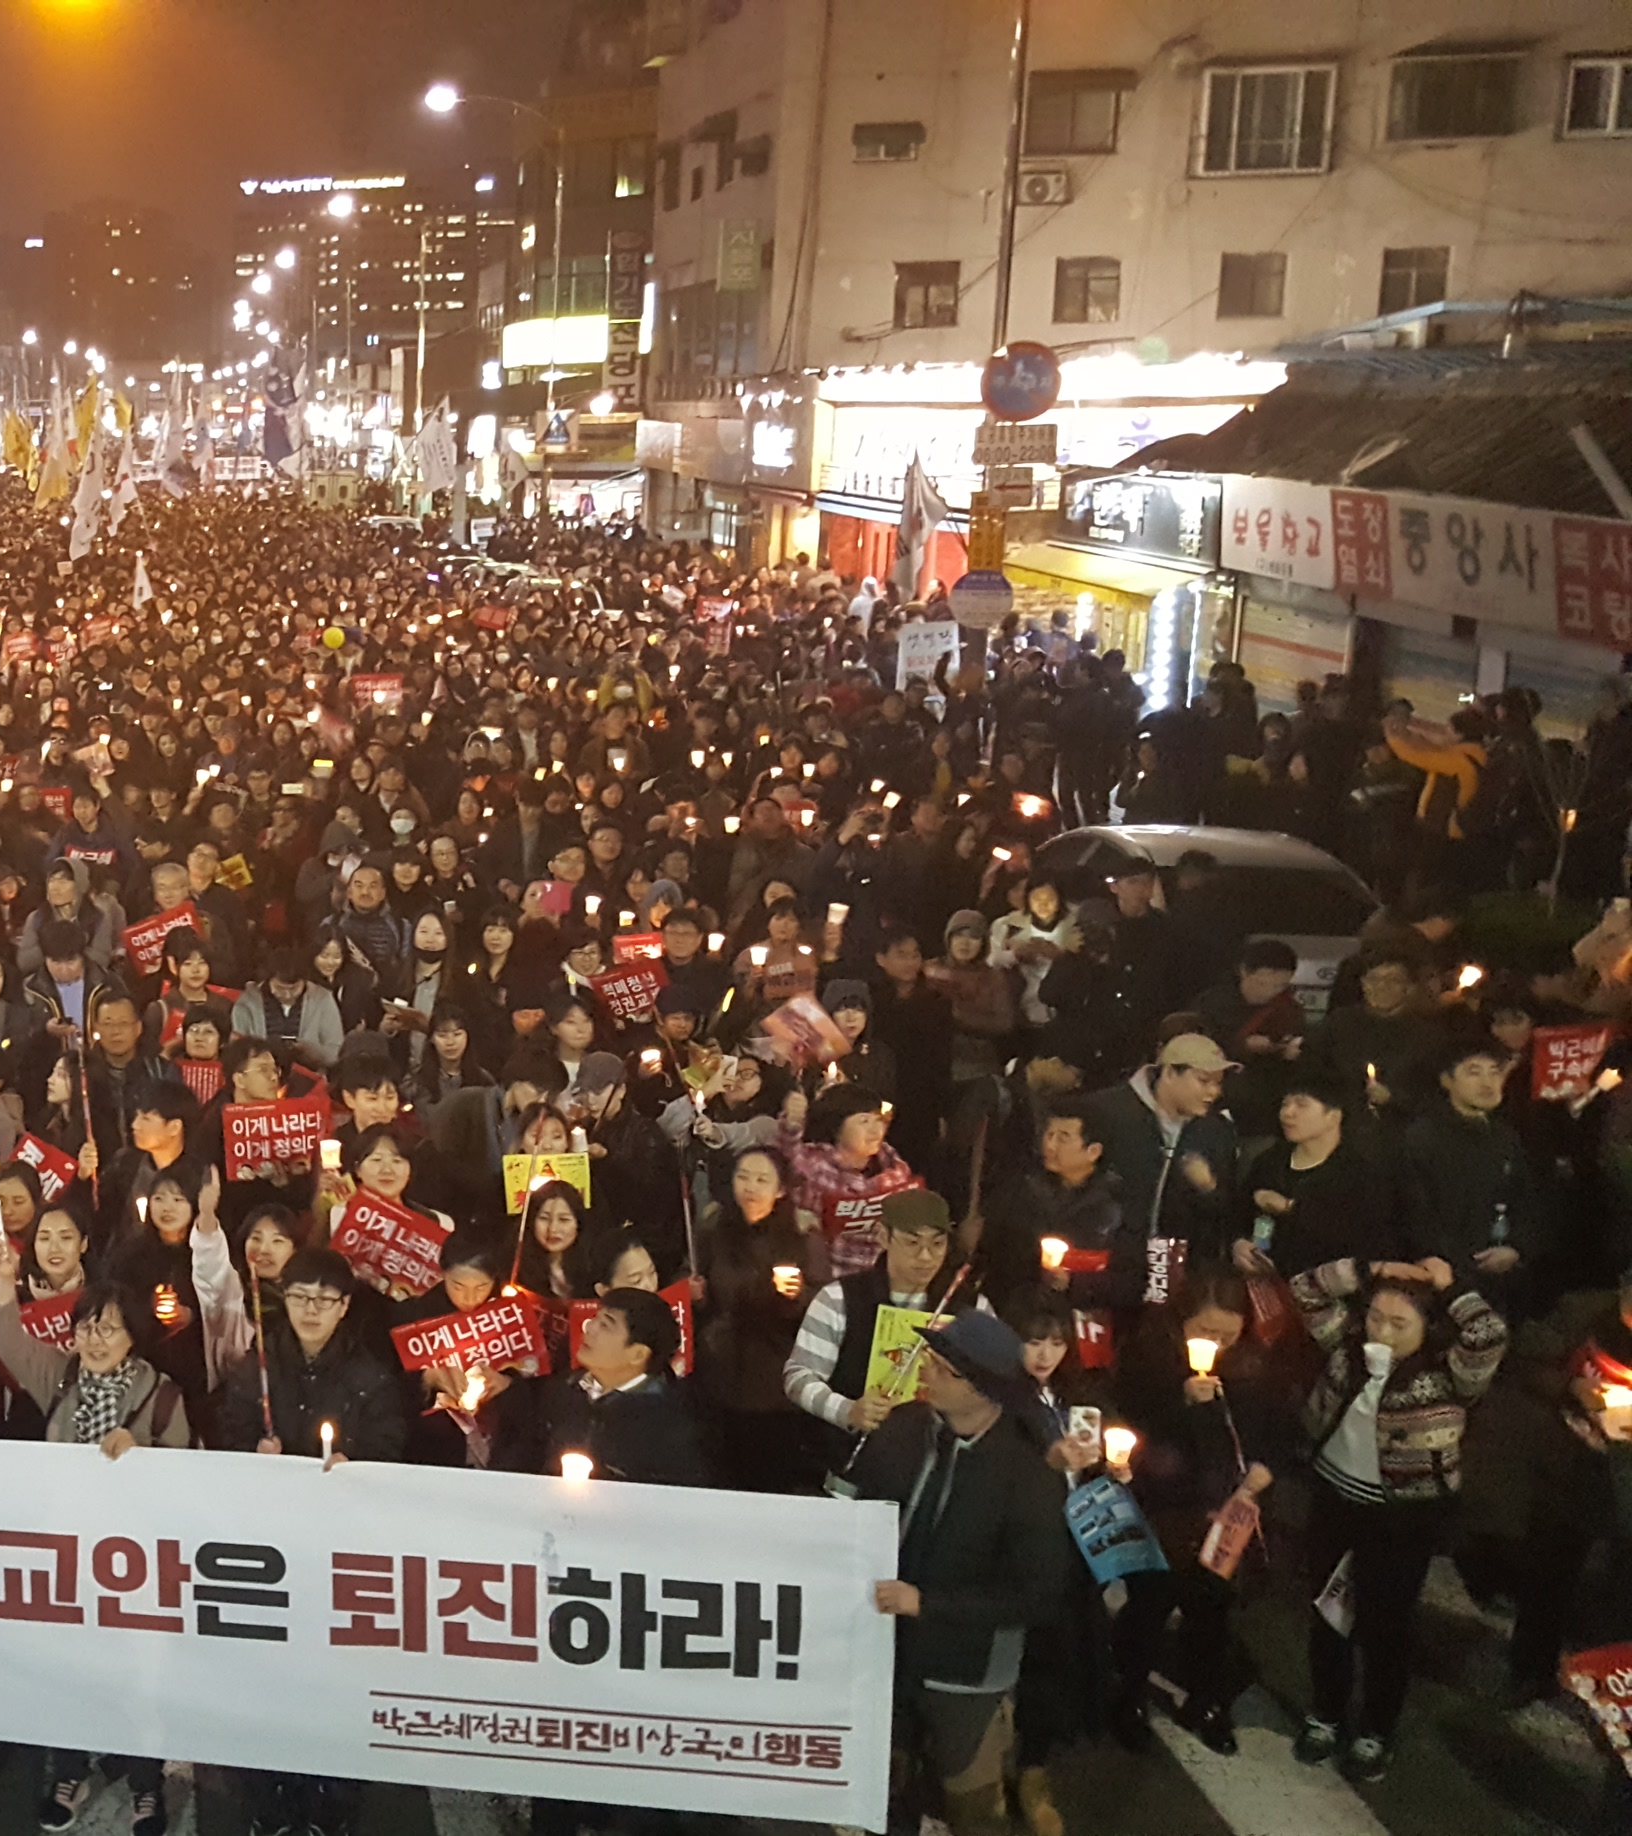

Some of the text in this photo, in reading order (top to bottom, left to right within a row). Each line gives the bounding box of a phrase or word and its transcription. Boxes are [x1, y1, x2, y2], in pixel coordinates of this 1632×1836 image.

[1399, 507, 1539, 593] 중앙사
[232, 1110, 321, 1138] 이게 나라다
[234, 1139, 270, 1160] 이게
[355, 1206, 396, 1240] 이게
[407, 1302, 524, 1357] 이게 나라다
[467, 1328, 534, 1368] 정의다
[329, 1551, 803, 1681] 퇴진하라!
